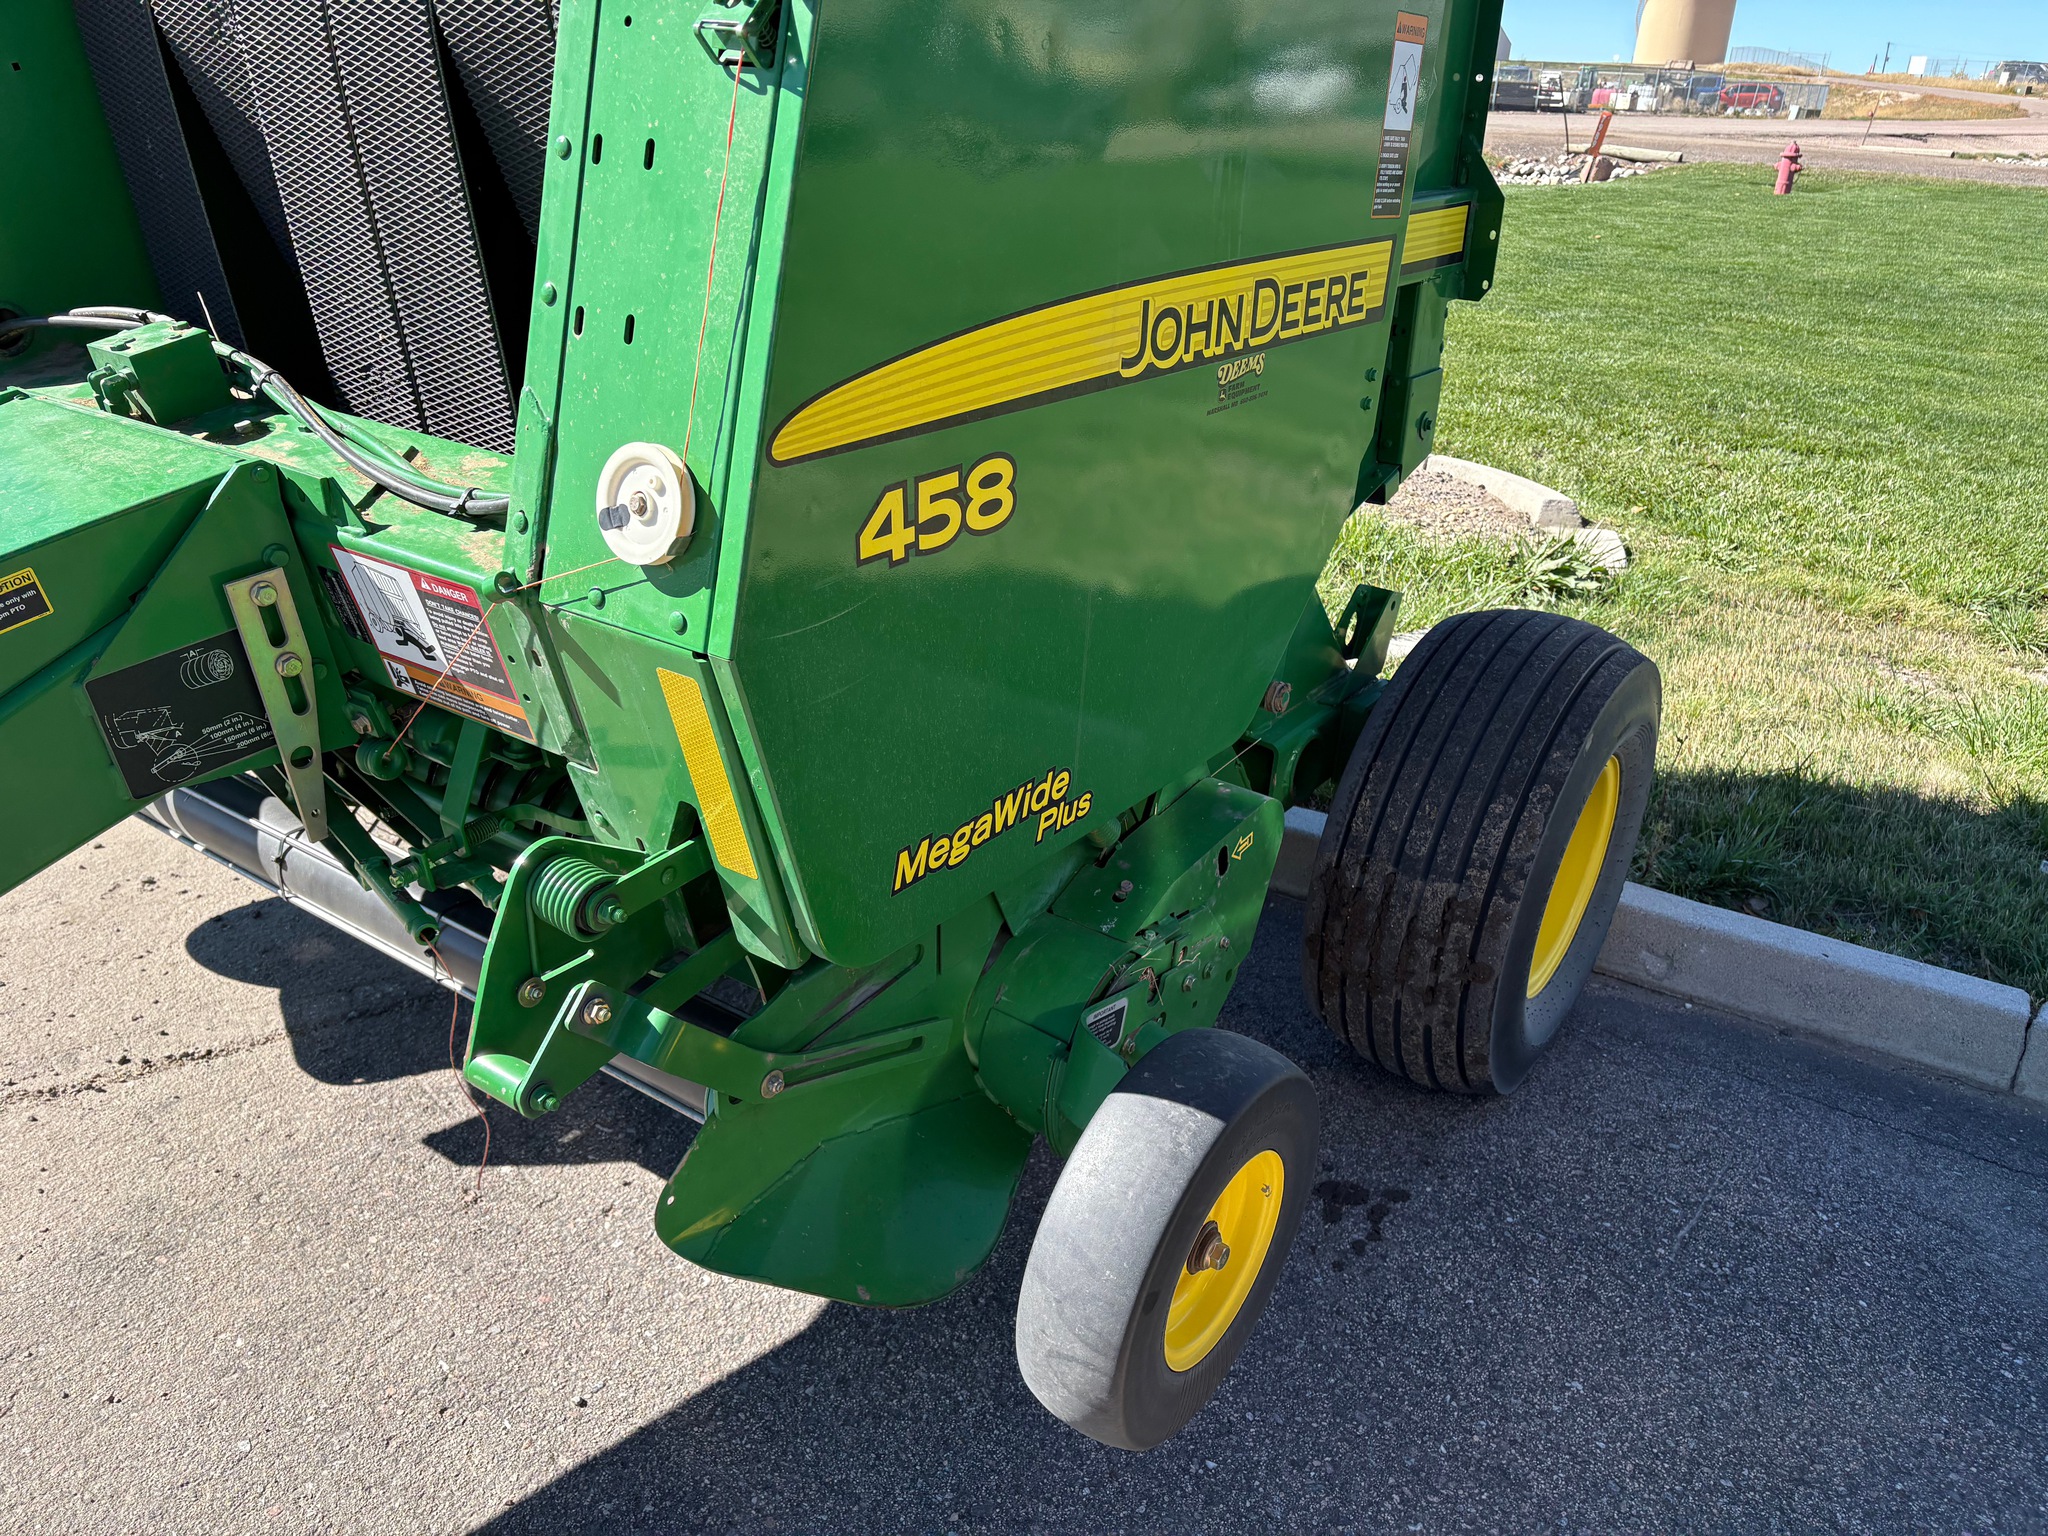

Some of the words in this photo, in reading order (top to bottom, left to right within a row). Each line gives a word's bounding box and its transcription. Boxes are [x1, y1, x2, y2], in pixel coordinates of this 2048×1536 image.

[1402, 25, 1425, 38] WARNING
[1120, 294, 1246, 370] JOHN
[1251, 269, 1370, 341] DEERE
[1217, 353, 1265, 386] DEEMS
[1227, 384, 1260, 400] EQUIPMENT
[1228, 381, 1245, 392] FARM
[858, 455, 1016, 563] 458
[5, 596, 20, 606] only
[21, 589, 37, 599] with
[430, 583, 468, 602] DANGER
[10, 604, 26, 614] PTO
[446, 681, 484, 702] WARNING
[175, 730, 182, 738] A
[201, 723, 223, 735] 50mm
[231, 715, 243, 724] in.)
[210, 728, 234, 740] 100mm
[242, 719, 254, 728] in.)
[224, 732, 248, 744] 150mm
[256, 723, 267, 732] in.)
[236, 737, 260, 748] 200mm
[1036, 791, 1092, 843] Plus
[893, 770, 1070, 891] MegaWide
